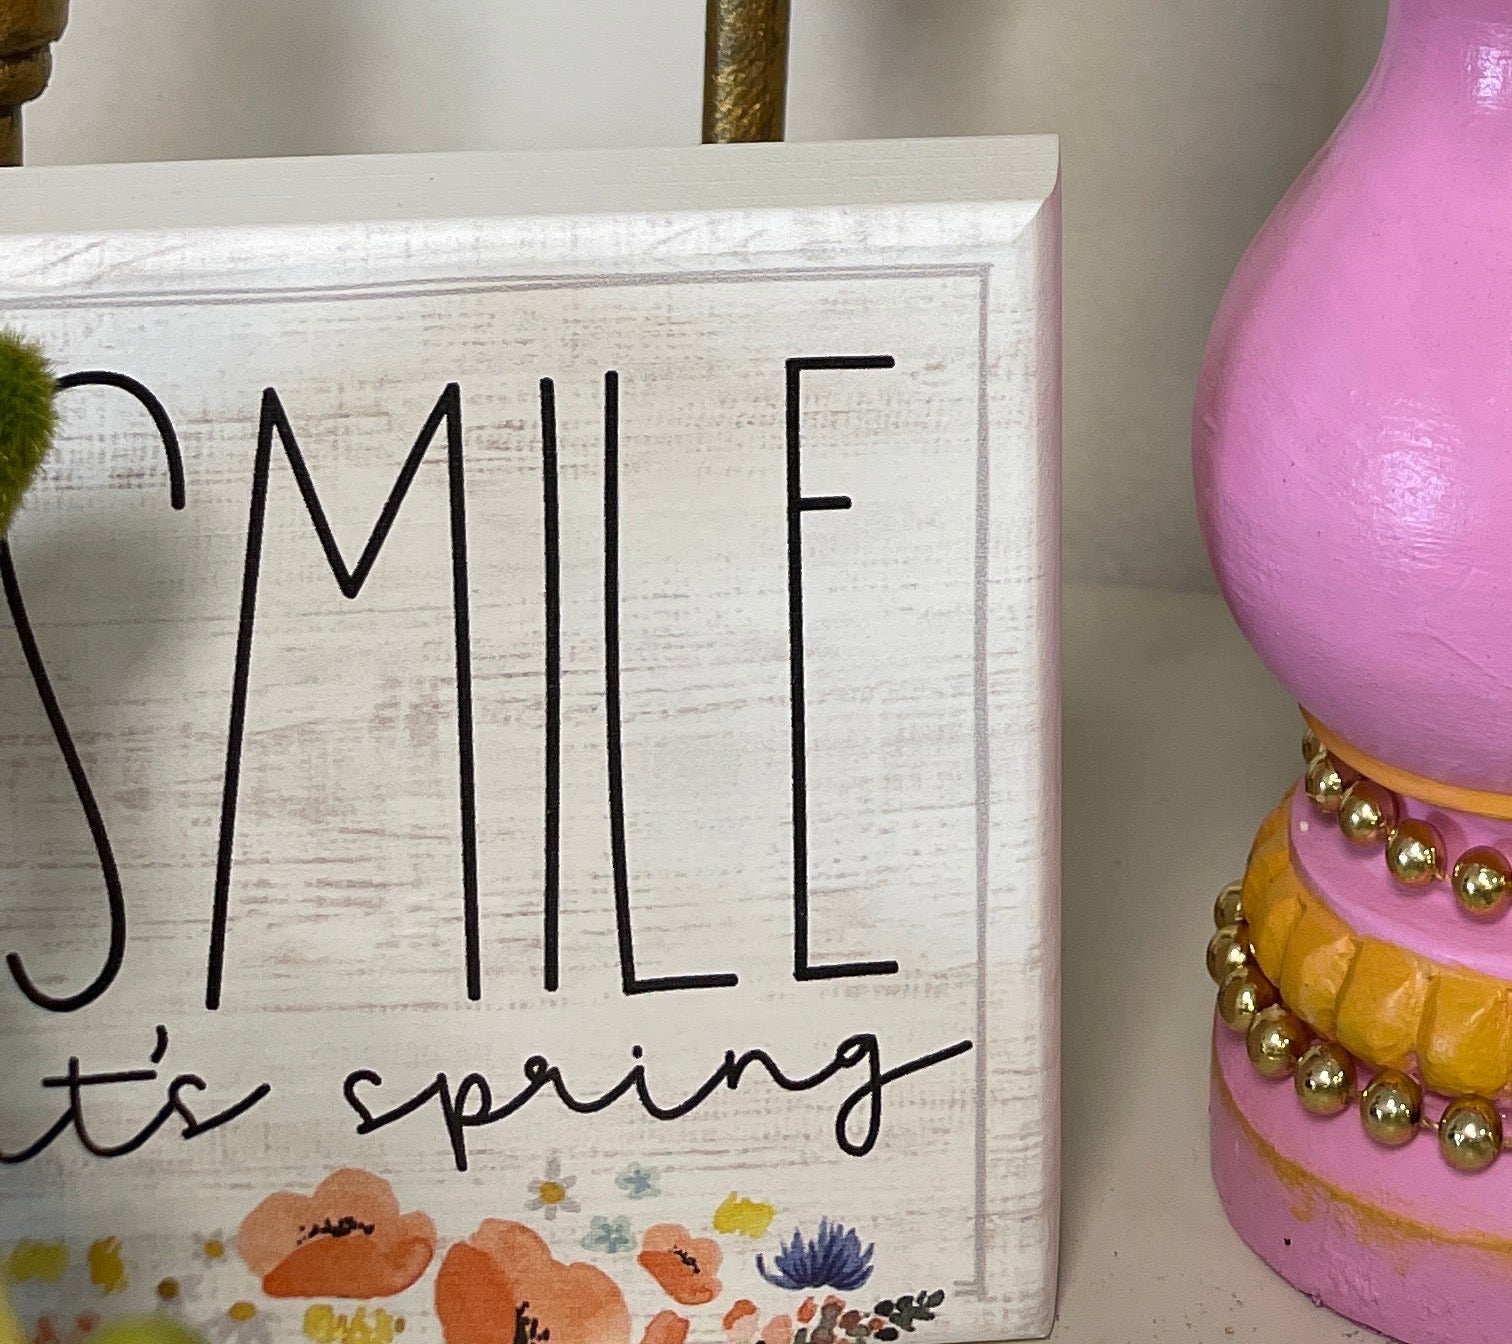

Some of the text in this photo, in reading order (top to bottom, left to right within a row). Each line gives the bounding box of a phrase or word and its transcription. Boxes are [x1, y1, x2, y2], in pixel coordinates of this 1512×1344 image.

[0, 354, 899, 1012] SMILE
[0, 1023, 973, 1171] t's spring
